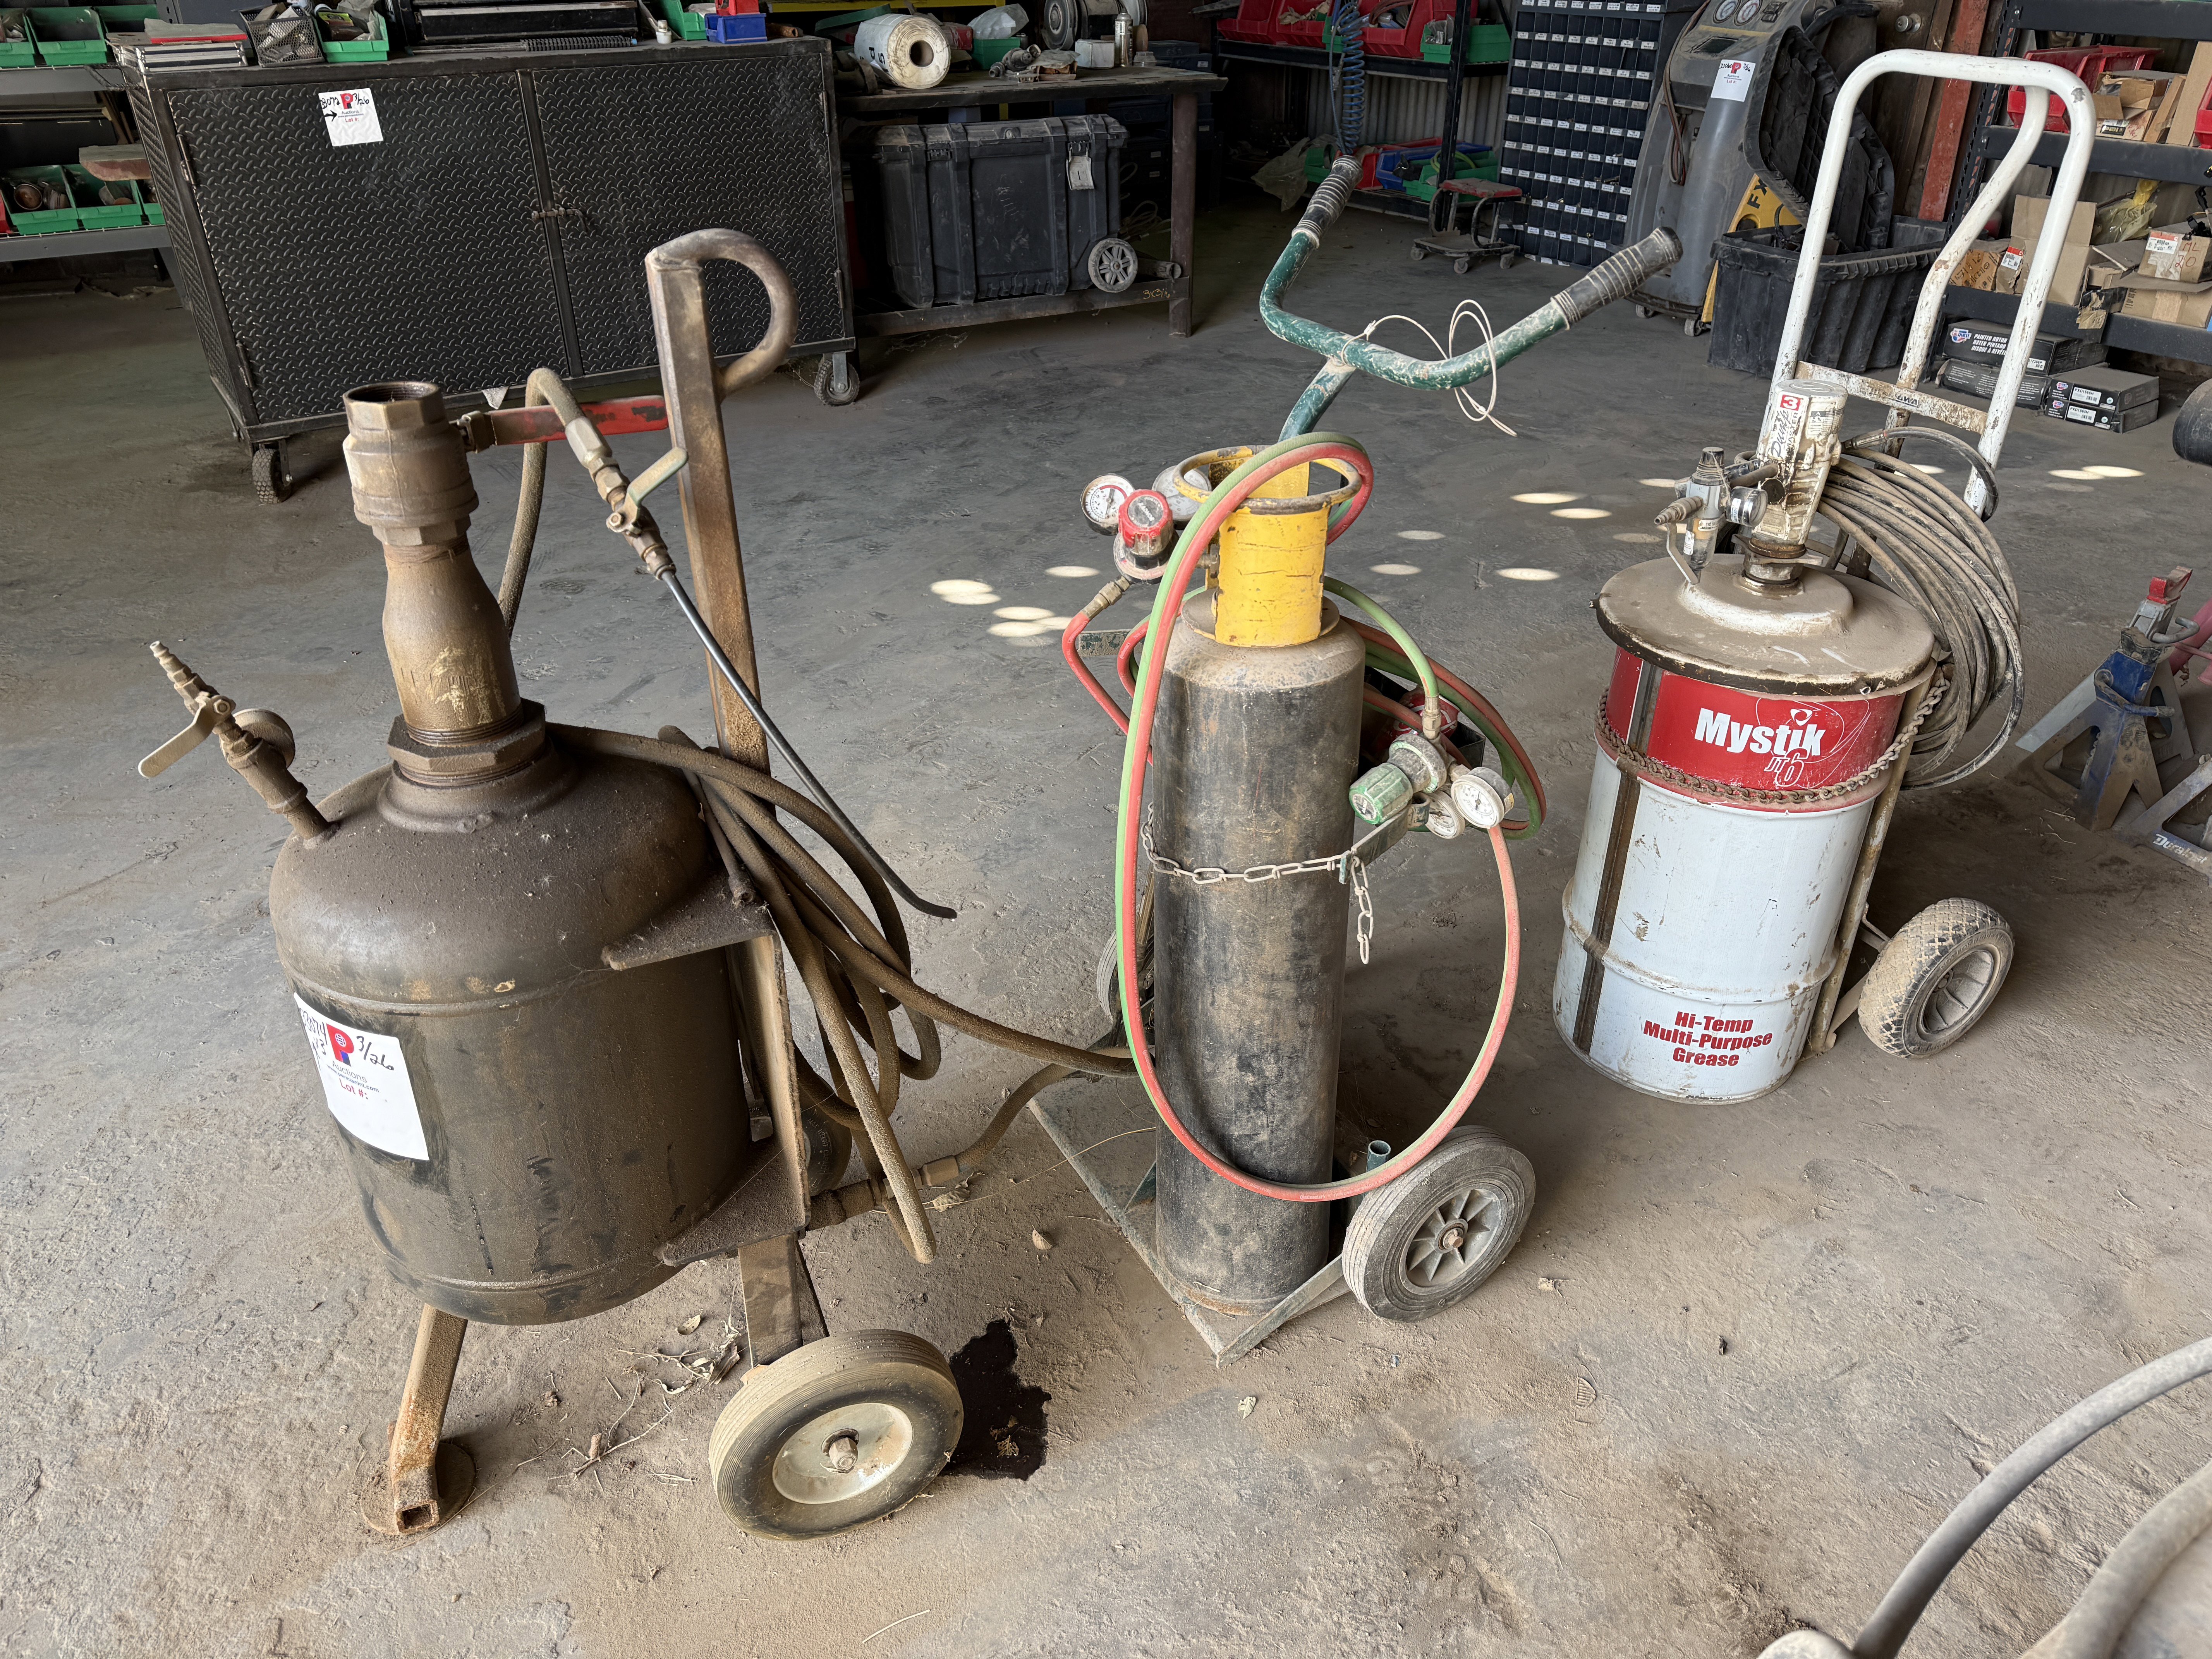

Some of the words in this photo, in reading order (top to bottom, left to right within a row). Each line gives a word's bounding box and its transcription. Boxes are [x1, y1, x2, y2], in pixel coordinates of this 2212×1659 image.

[1694, 707, 1826, 756] Mystik
[1674, 1011, 1753, 1033] Hi-Temp
[1643, 1020, 1773, 1051] Multi-Purpose
[1673, 1047, 1740, 1066] Grease
[332, 1060, 367, 1083] Auctions
[339, 1078, 356, 1095] Lot
